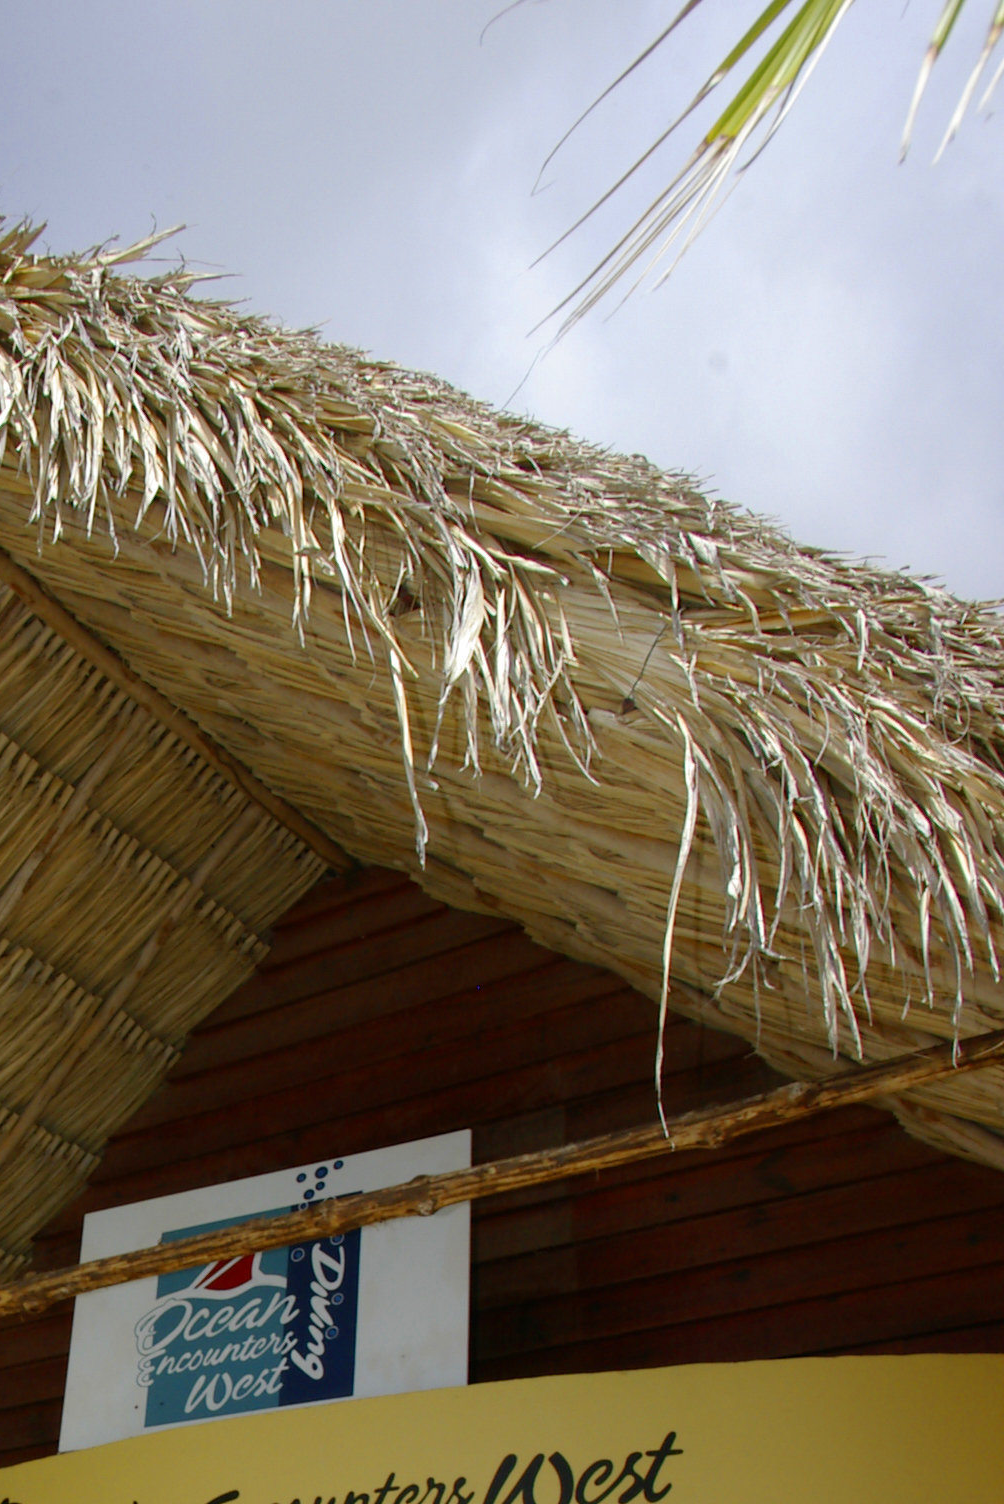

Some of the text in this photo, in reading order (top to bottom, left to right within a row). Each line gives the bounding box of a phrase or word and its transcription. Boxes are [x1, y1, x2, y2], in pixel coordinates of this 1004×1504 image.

[136, 1293, 299, 1356] Ocean
[292, 1243, 346, 1380] Diving
[137, 1331, 298, 1388] Encounters
[184, 1357, 290, 1414] West
